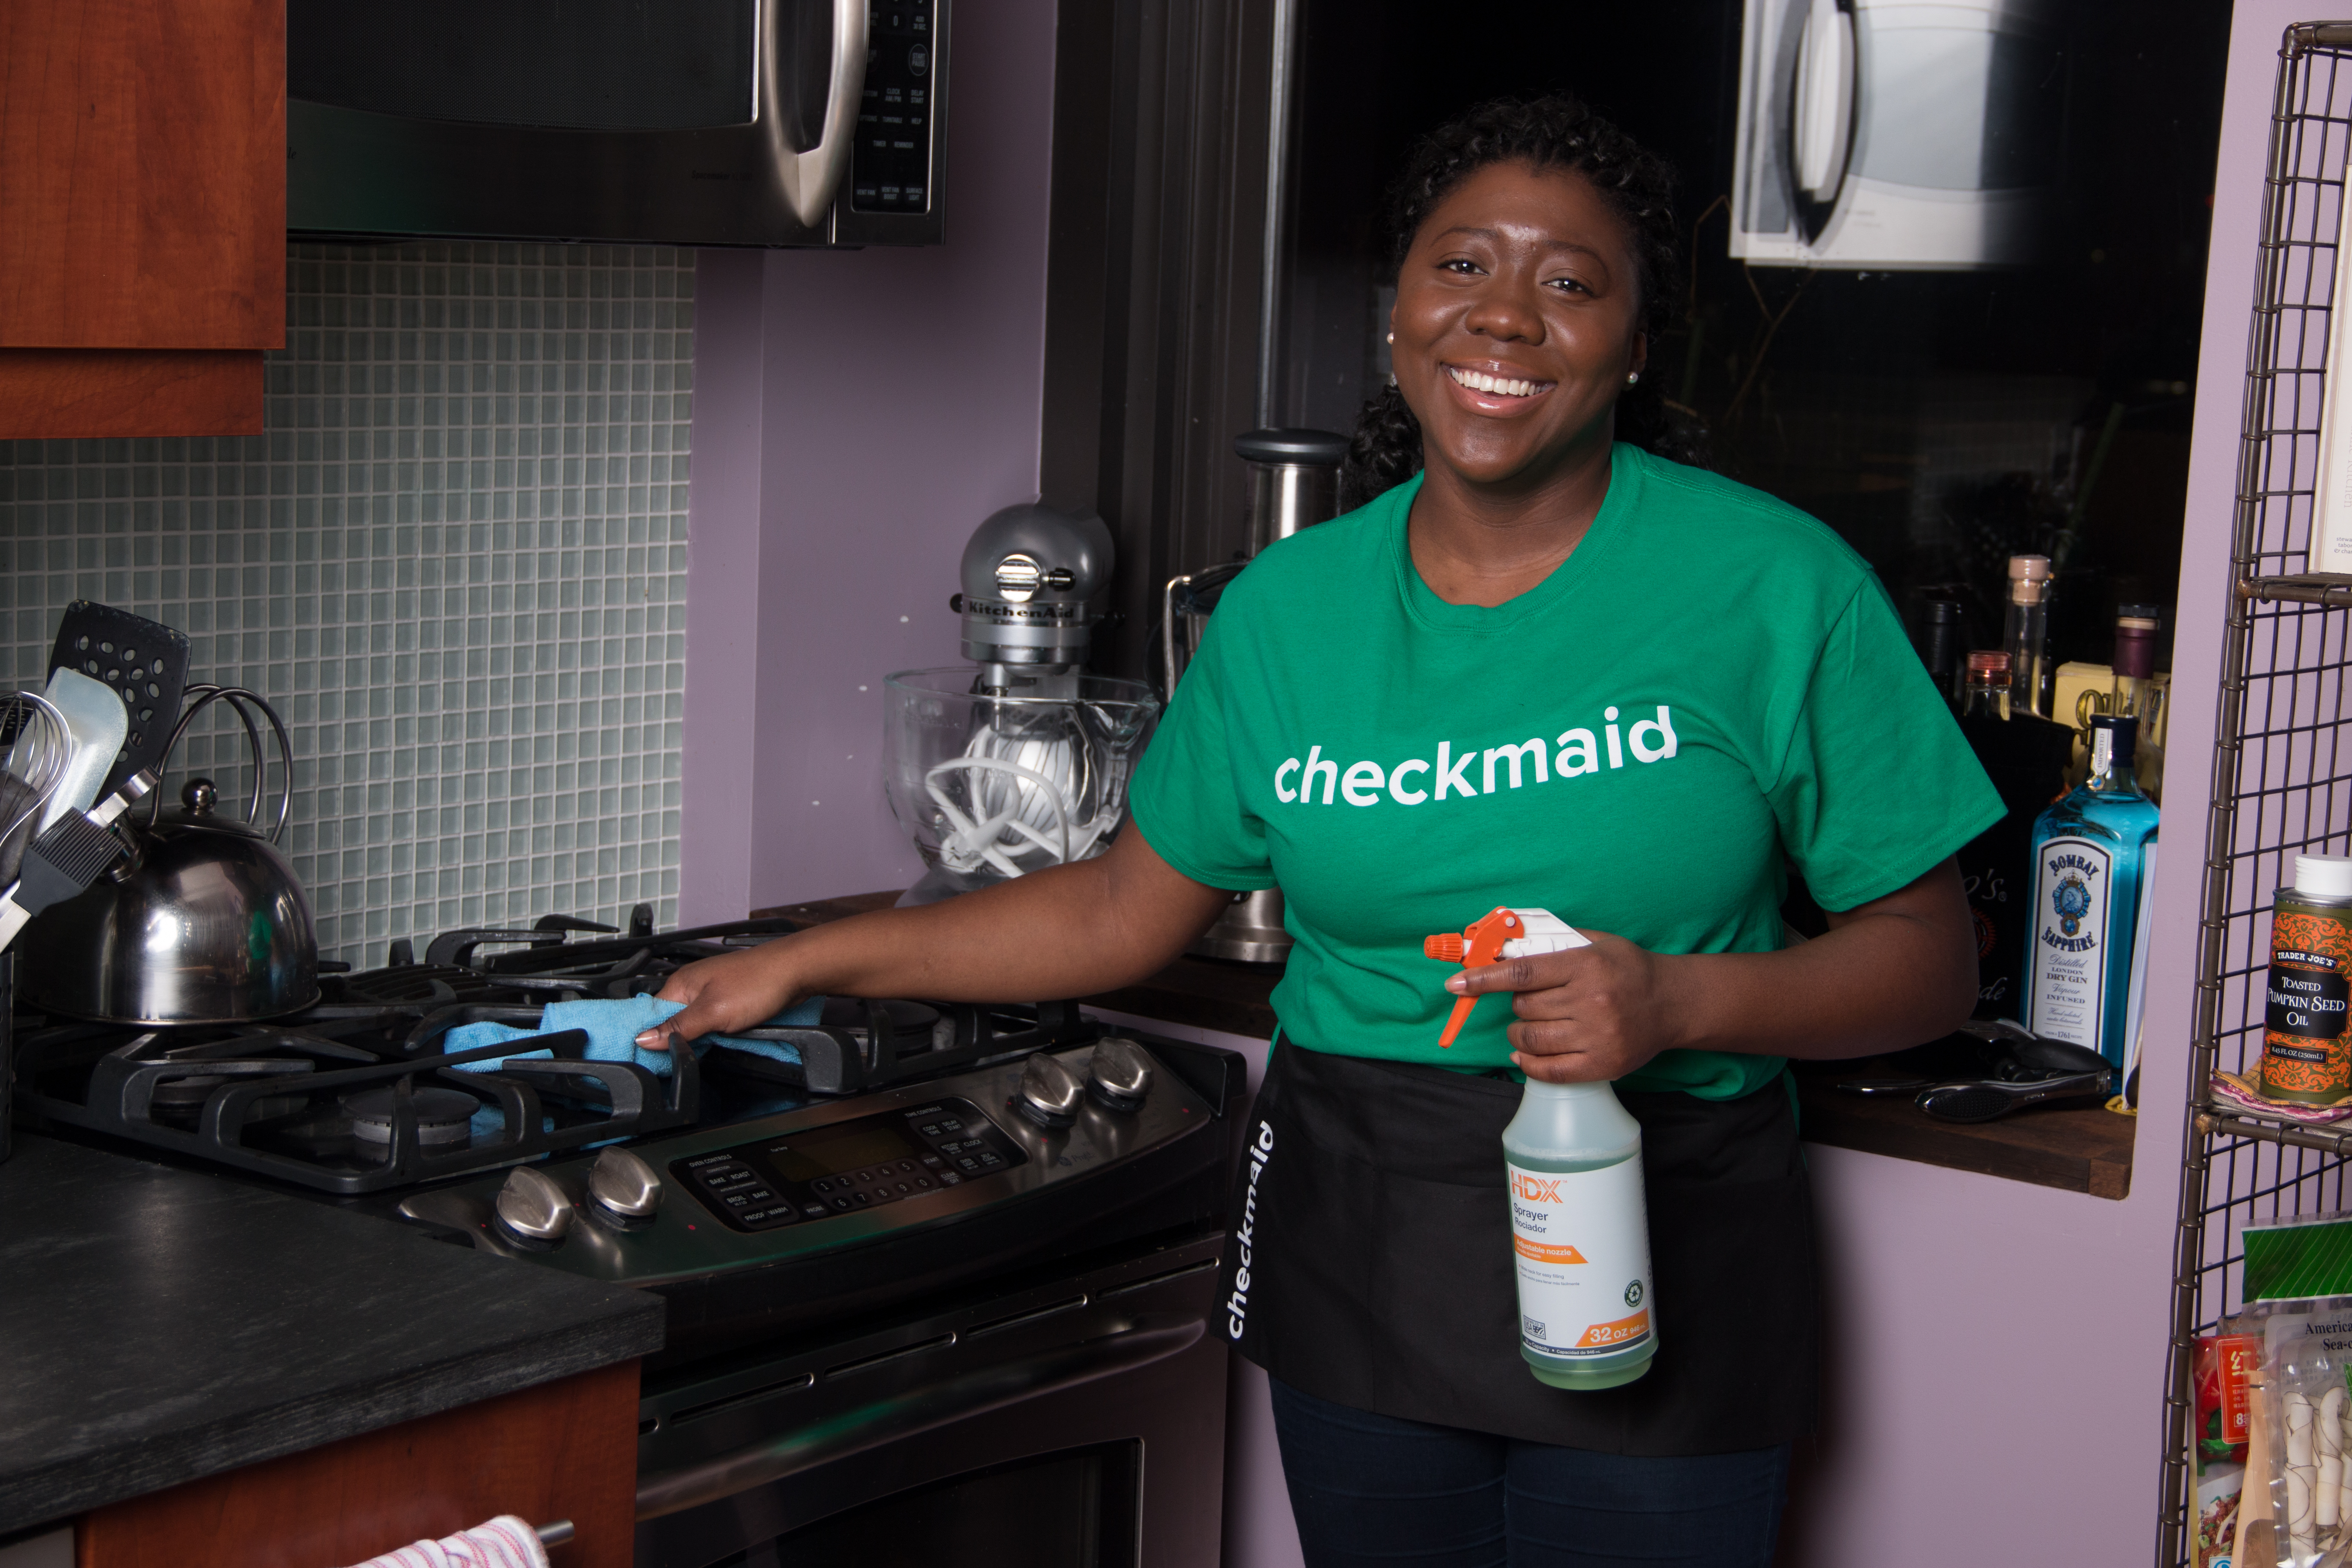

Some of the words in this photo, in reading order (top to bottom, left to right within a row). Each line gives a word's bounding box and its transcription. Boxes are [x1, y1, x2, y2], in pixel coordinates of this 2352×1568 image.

[893, 15, 899, 27] 0
[691, 170, 731, 181] Spacemaker
[969, 602, 1074, 618] KitchenAid
[1274, 705, 1678, 807] checkmaid
[2048, 854, 2100, 881] BOMBAY
[2041, 926, 2096, 952] SAPPHIRE
[2048, 954, 2088, 969] Distilled
[2277, 952, 2306, 961] TRADER
[2307, 954, 2334, 966] JOE'S
[2052, 967, 2083, 975] LONDON
[2046, 973, 2067, 981] DRY
[2068, 975, 2088, 984] GIN
[2282, 976, 2321, 992] TOASTED
[2052, 983, 2080, 995] Vapour
[2046, 994, 2086, 1004] INFUSED
[2267, 987, 2309, 1009] PUMPKIN
[2311, 996, 2345, 1011] SEED
[2287, 1011, 2309, 1026] OIL
[2298, 1051, 2323, 1060] (250mL)
[917, 1106, 942, 1115] CONTROLS
[964, 1139, 983, 1148] CLOCK
[689, 1159, 704, 1168] OVEN
[704, 1154, 732, 1165] CONTROLS
[707, 1165, 730, 1174] CONVECTION
[709, 1176, 726, 1185] BAKE
[730, 1170, 751, 1180] ROAST
[1510, 1170, 1564, 1204] HDX
[726, 1195, 747, 1204] BROIL
[752, 1190, 770, 1199] BAKE
[744, 1212, 765, 1222] PROOF
[768, 1206, 788, 1216] WARM
[806, 1205, 824, 1213] PROBE
[1514, 1202, 1548, 1221] Sprayer
[1227, 1120, 1273, 1339] checkmaid
[1515, 1216, 1547, 1233] Rociador
[1517, 1238, 1545, 1253] Adjustable
[1524, 1317, 1539, 1327] ASSEMBLED
[1525, 1321, 1533, 1332] USA
[1590, 1326, 1611, 1343] 32
[1614, 1328, 1628, 1339] oz
[1630, 1324, 1640, 1334] 946
[1531, 1342, 1550, 1353] Capacity
